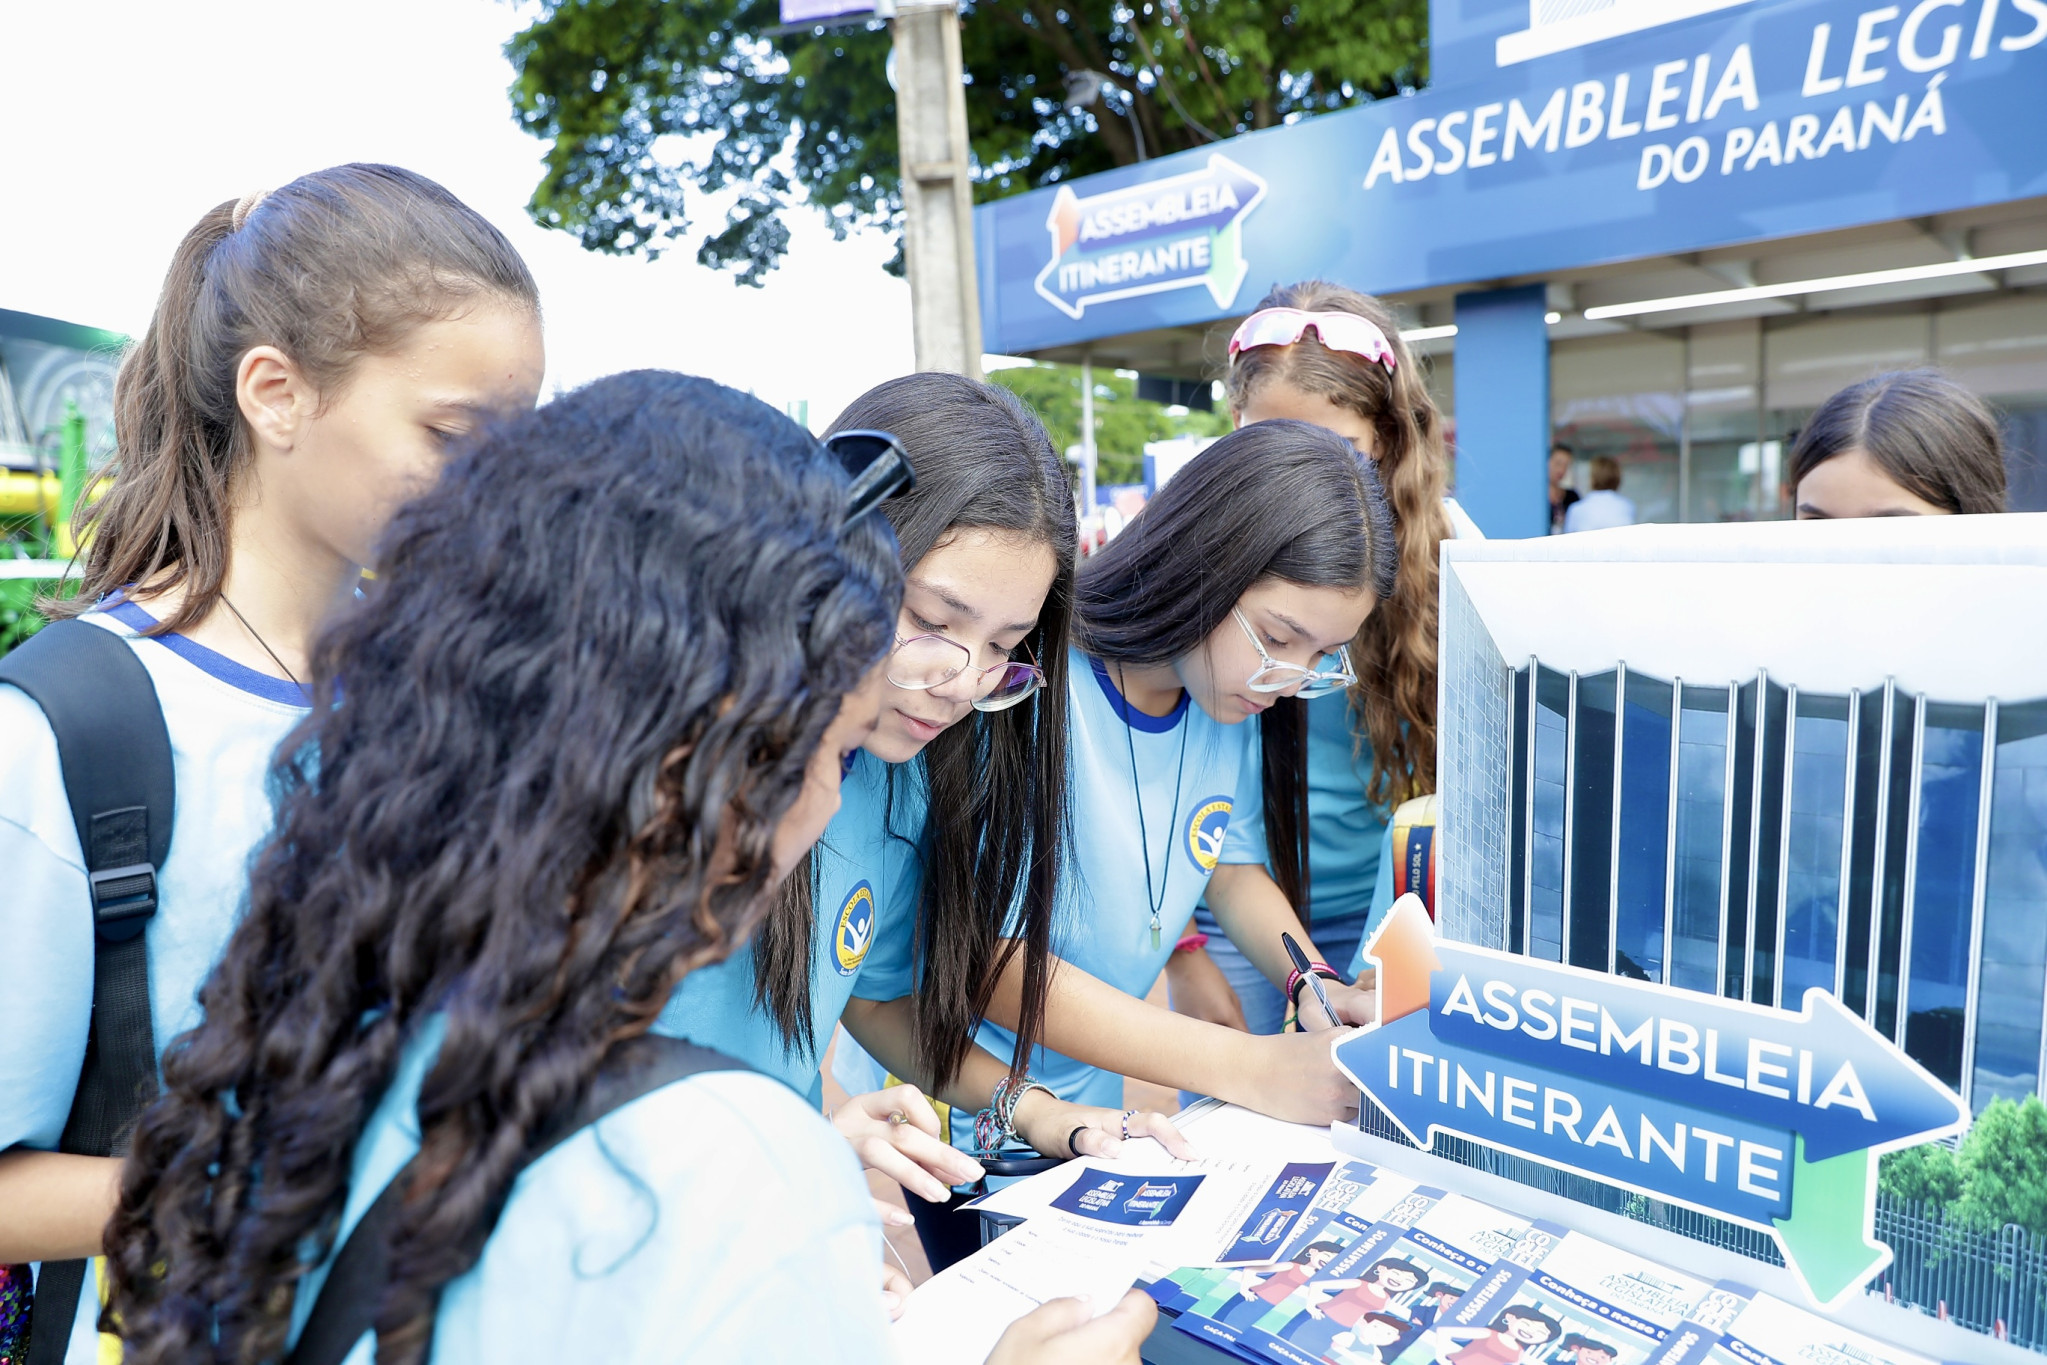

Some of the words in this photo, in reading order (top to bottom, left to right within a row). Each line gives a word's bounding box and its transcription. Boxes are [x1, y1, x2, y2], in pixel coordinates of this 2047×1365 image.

[1363, 43, 1760, 190] ASSEMBLEIA
[1637, 137, 1709, 191] DO
[1721, 71, 1947, 175] PARANÁ
[1078, 182, 1240, 243] ASSEMBLEIA
[1058, 235, 1212, 294] ITINERANTE
[1411, 852, 1422, 868] SOL
[840, 892, 860, 928] ESCOLA
[1440, 974, 1878, 1122] ASSEMBLEIA
[1387, 1045, 1783, 1201] ITINERANTE
[1329, 1229, 1388, 1278] PASSATEMPOS
[1413, 1232, 1466, 1262] Conheça
[1466, 1260, 1477, 1268] o
[1455, 1269, 1512, 1325] PASSATEMPOS
[1539, 1275, 1598, 1311] Conheça
[1598, 1306, 1610, 1315] o
[1610, 1311, 1655, 1334] nosso
[1599, 1279, 1685, 1317] LEGISLATIVA
[1604, 1274, 1689, 1311] ASSEMBLEIA
